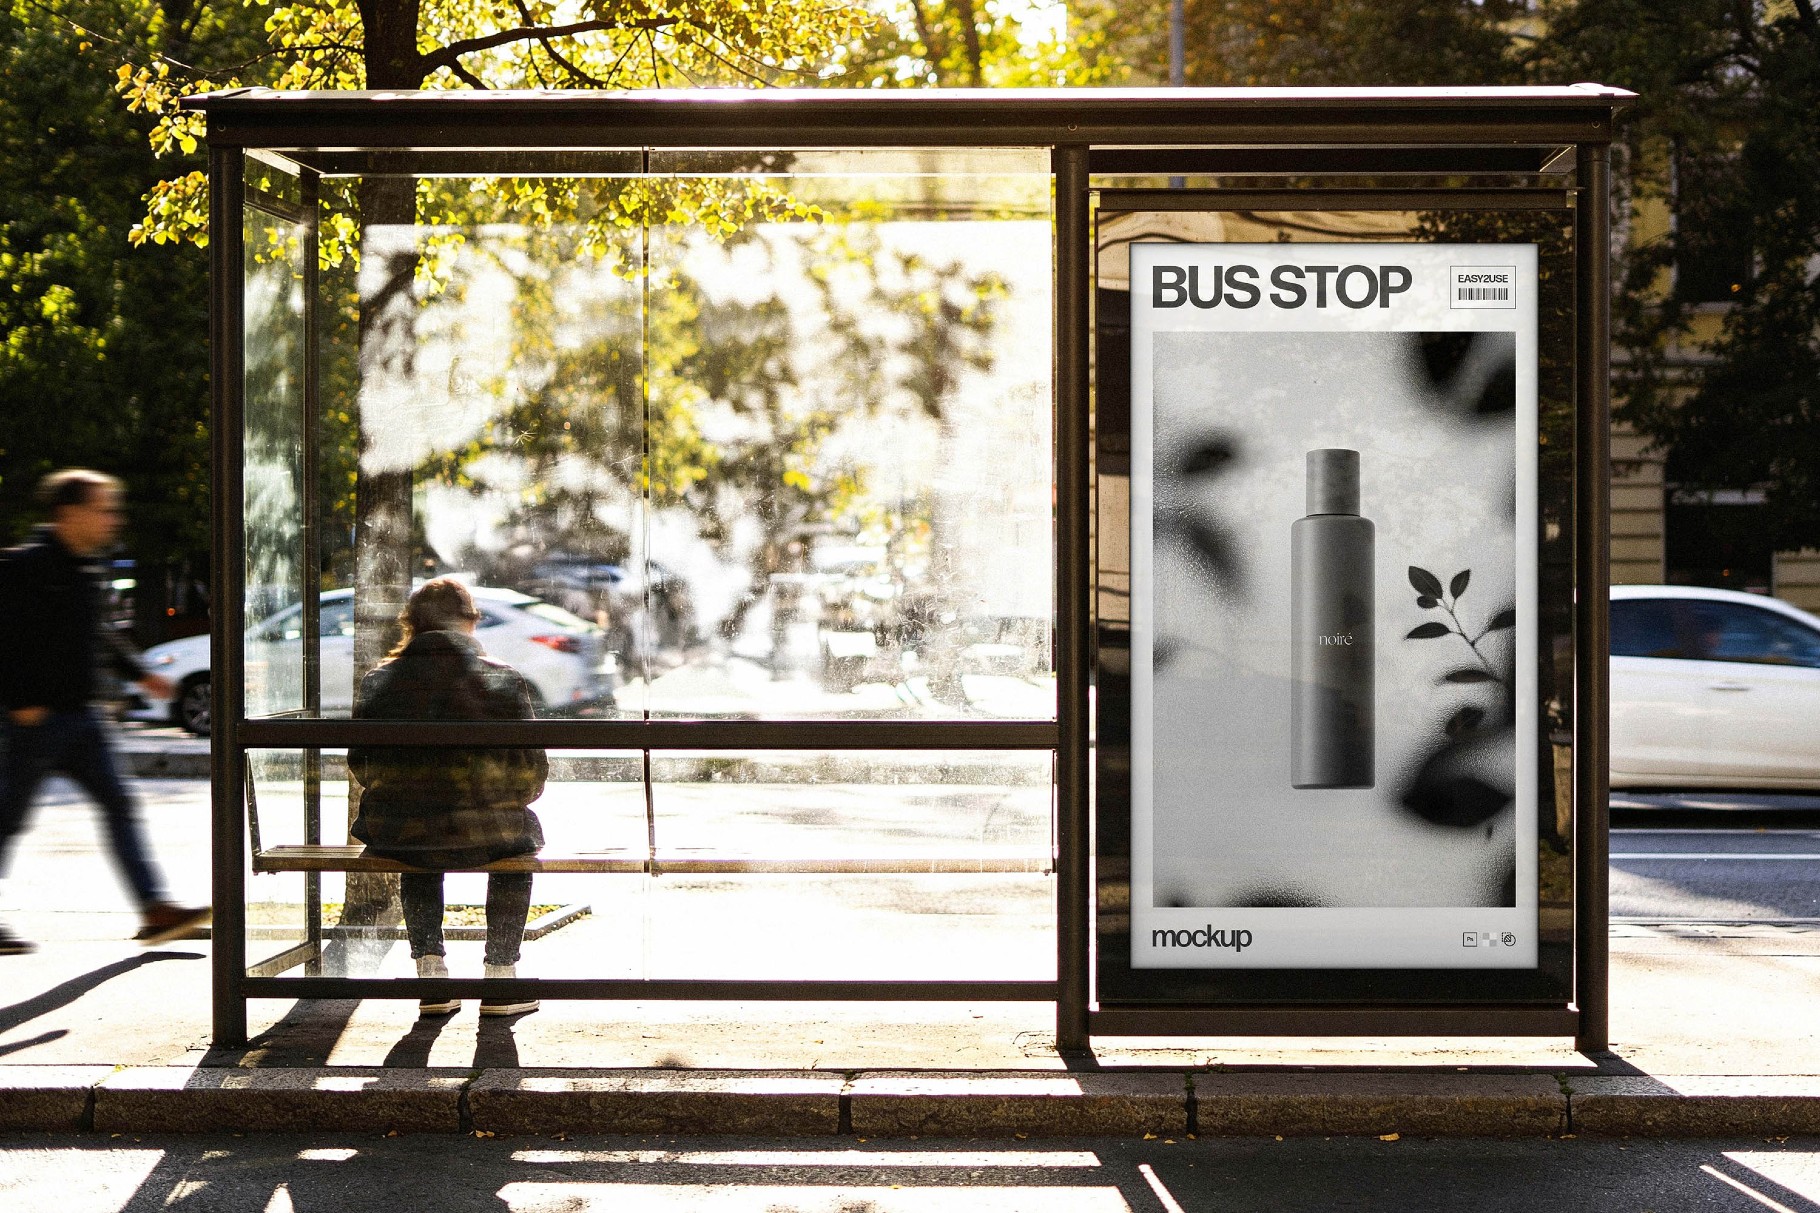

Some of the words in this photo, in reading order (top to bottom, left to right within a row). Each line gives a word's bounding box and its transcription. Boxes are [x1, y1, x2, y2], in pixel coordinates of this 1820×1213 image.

[1152, 264, 1261, 309] BUS
[1270, 264, 1413, 309] STOP
[1458, 274, 1509, 283] EASY2USE
[1319, 632, 1353, 646] noiré
[1152, 924, 1253, 952] mockup
